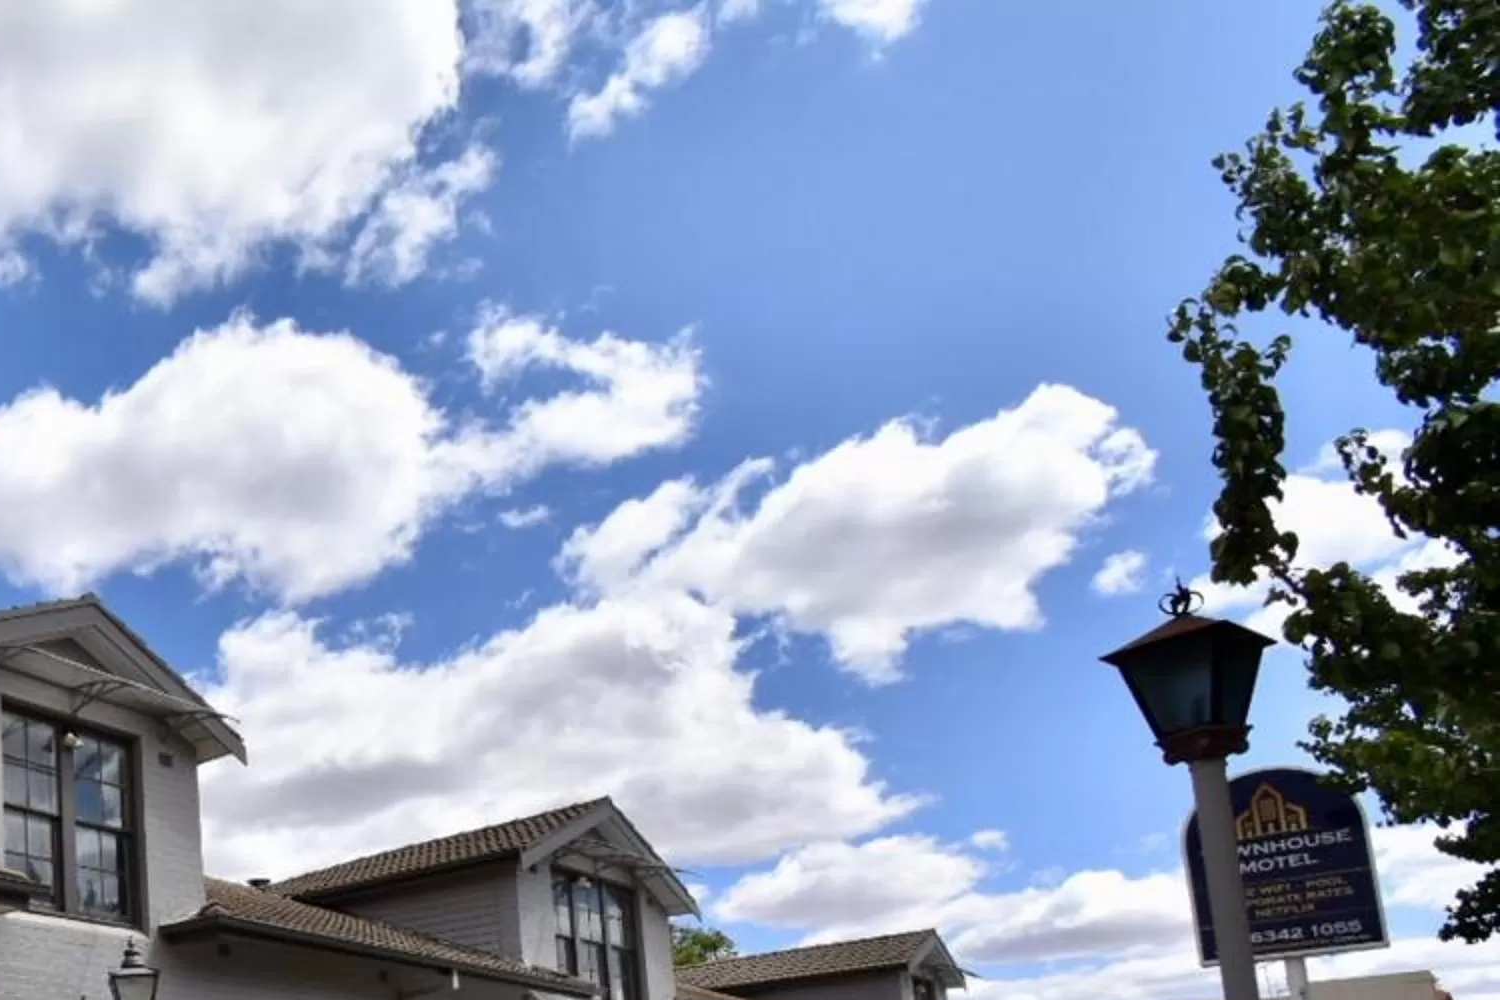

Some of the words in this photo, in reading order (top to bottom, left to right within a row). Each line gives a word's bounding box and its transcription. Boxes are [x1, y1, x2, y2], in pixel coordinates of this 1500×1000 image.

[1240, 853, 1320, 875] MOTEL
[1251, 927, 1303, 943] 6342
[1311, 919, 1362, 937] 1055
